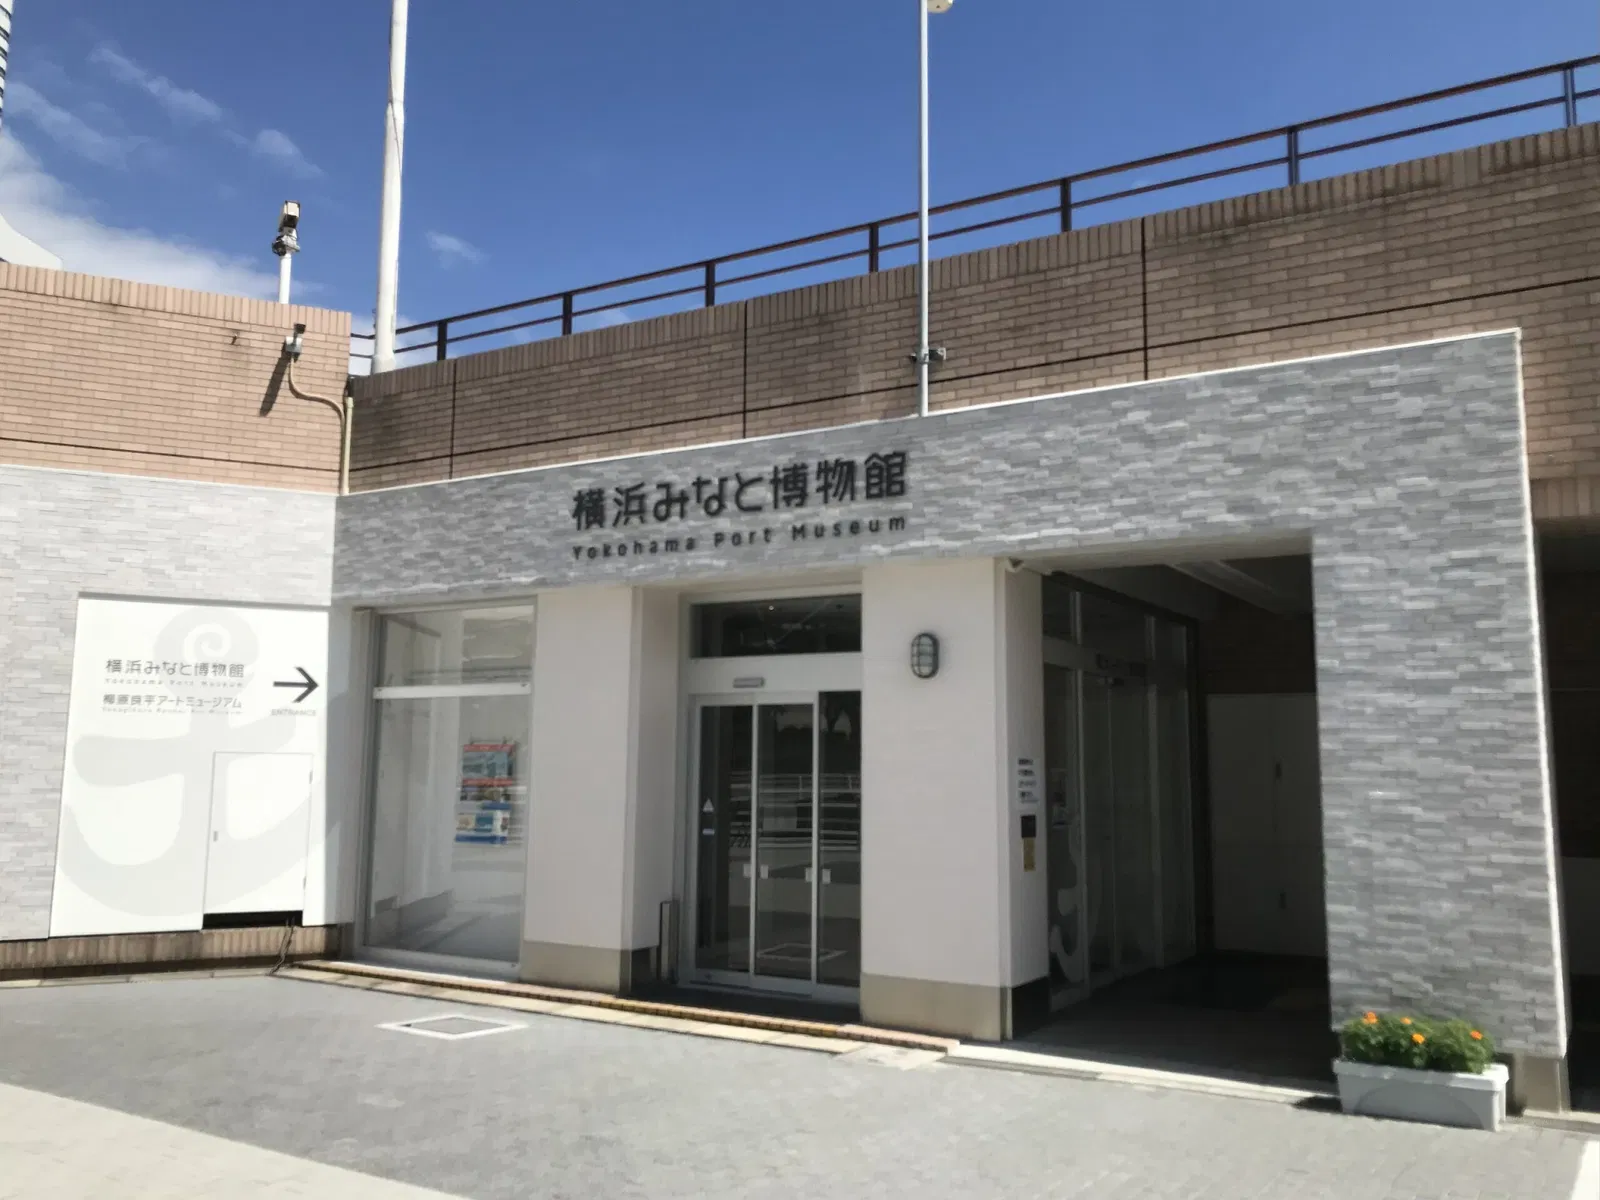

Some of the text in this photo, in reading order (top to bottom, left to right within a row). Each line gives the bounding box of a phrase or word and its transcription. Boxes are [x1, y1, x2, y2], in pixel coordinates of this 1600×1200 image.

[572, 451, 907, 532] 横浜みなと博物館
[572, 515, 906, 560] Yokohama Port Museum
[105, 659, 245, 678] 横浜みなと博物館
